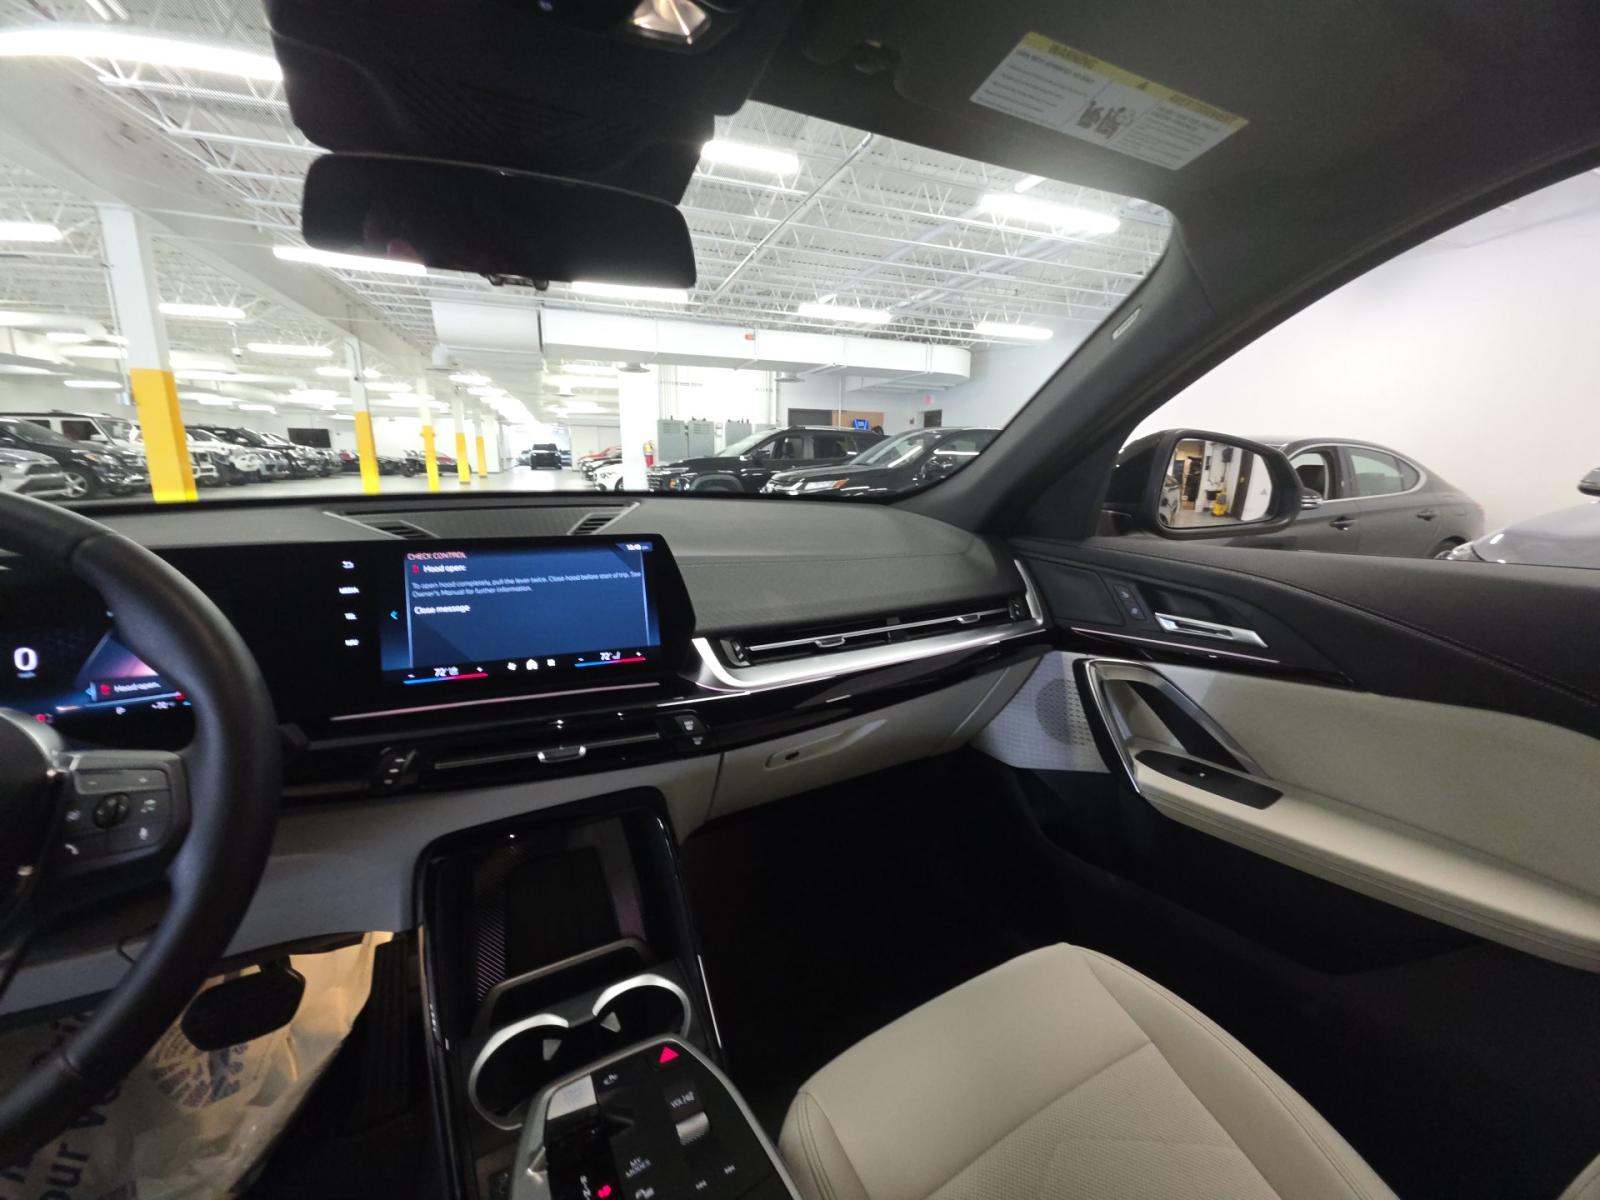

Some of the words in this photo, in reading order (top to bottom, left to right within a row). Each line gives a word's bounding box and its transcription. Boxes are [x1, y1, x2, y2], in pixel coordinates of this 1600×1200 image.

[407, 552, 432, 560] CHECK
[433, 551, 467, 559] CONTROL
[423, 565, 444, 573] Hood
[413, 606, 434, 614] Close
[435, 605, 470, 614] message
[14, 647, 38, 671] 0
